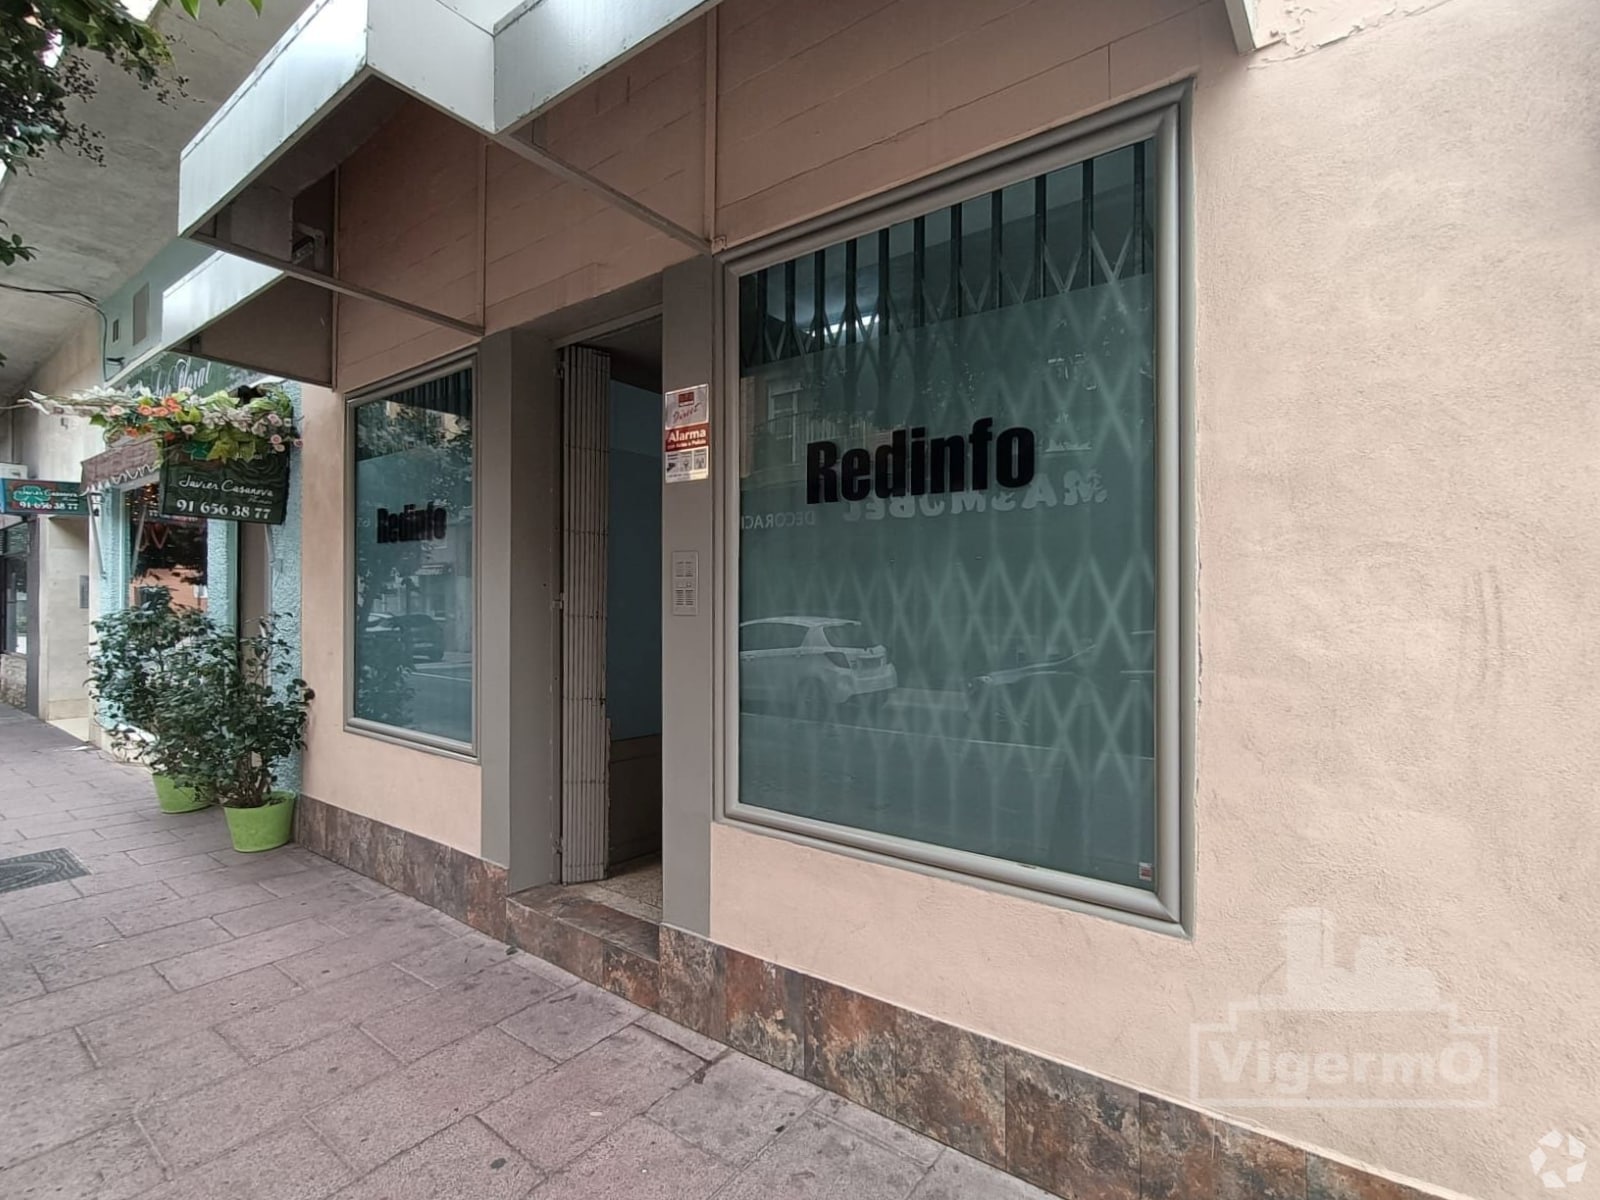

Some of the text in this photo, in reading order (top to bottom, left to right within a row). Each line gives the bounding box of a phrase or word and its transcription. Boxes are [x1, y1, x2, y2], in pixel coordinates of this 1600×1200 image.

[668, 429, 706, 442] Alarma
[806, 418, 1036, 505] Redinfo
[179, 474, 274, 497] Javier Casanova
[176, 499, 271, 519] 91 656 38 77
[377, 502, 447, 543] Redinfo
